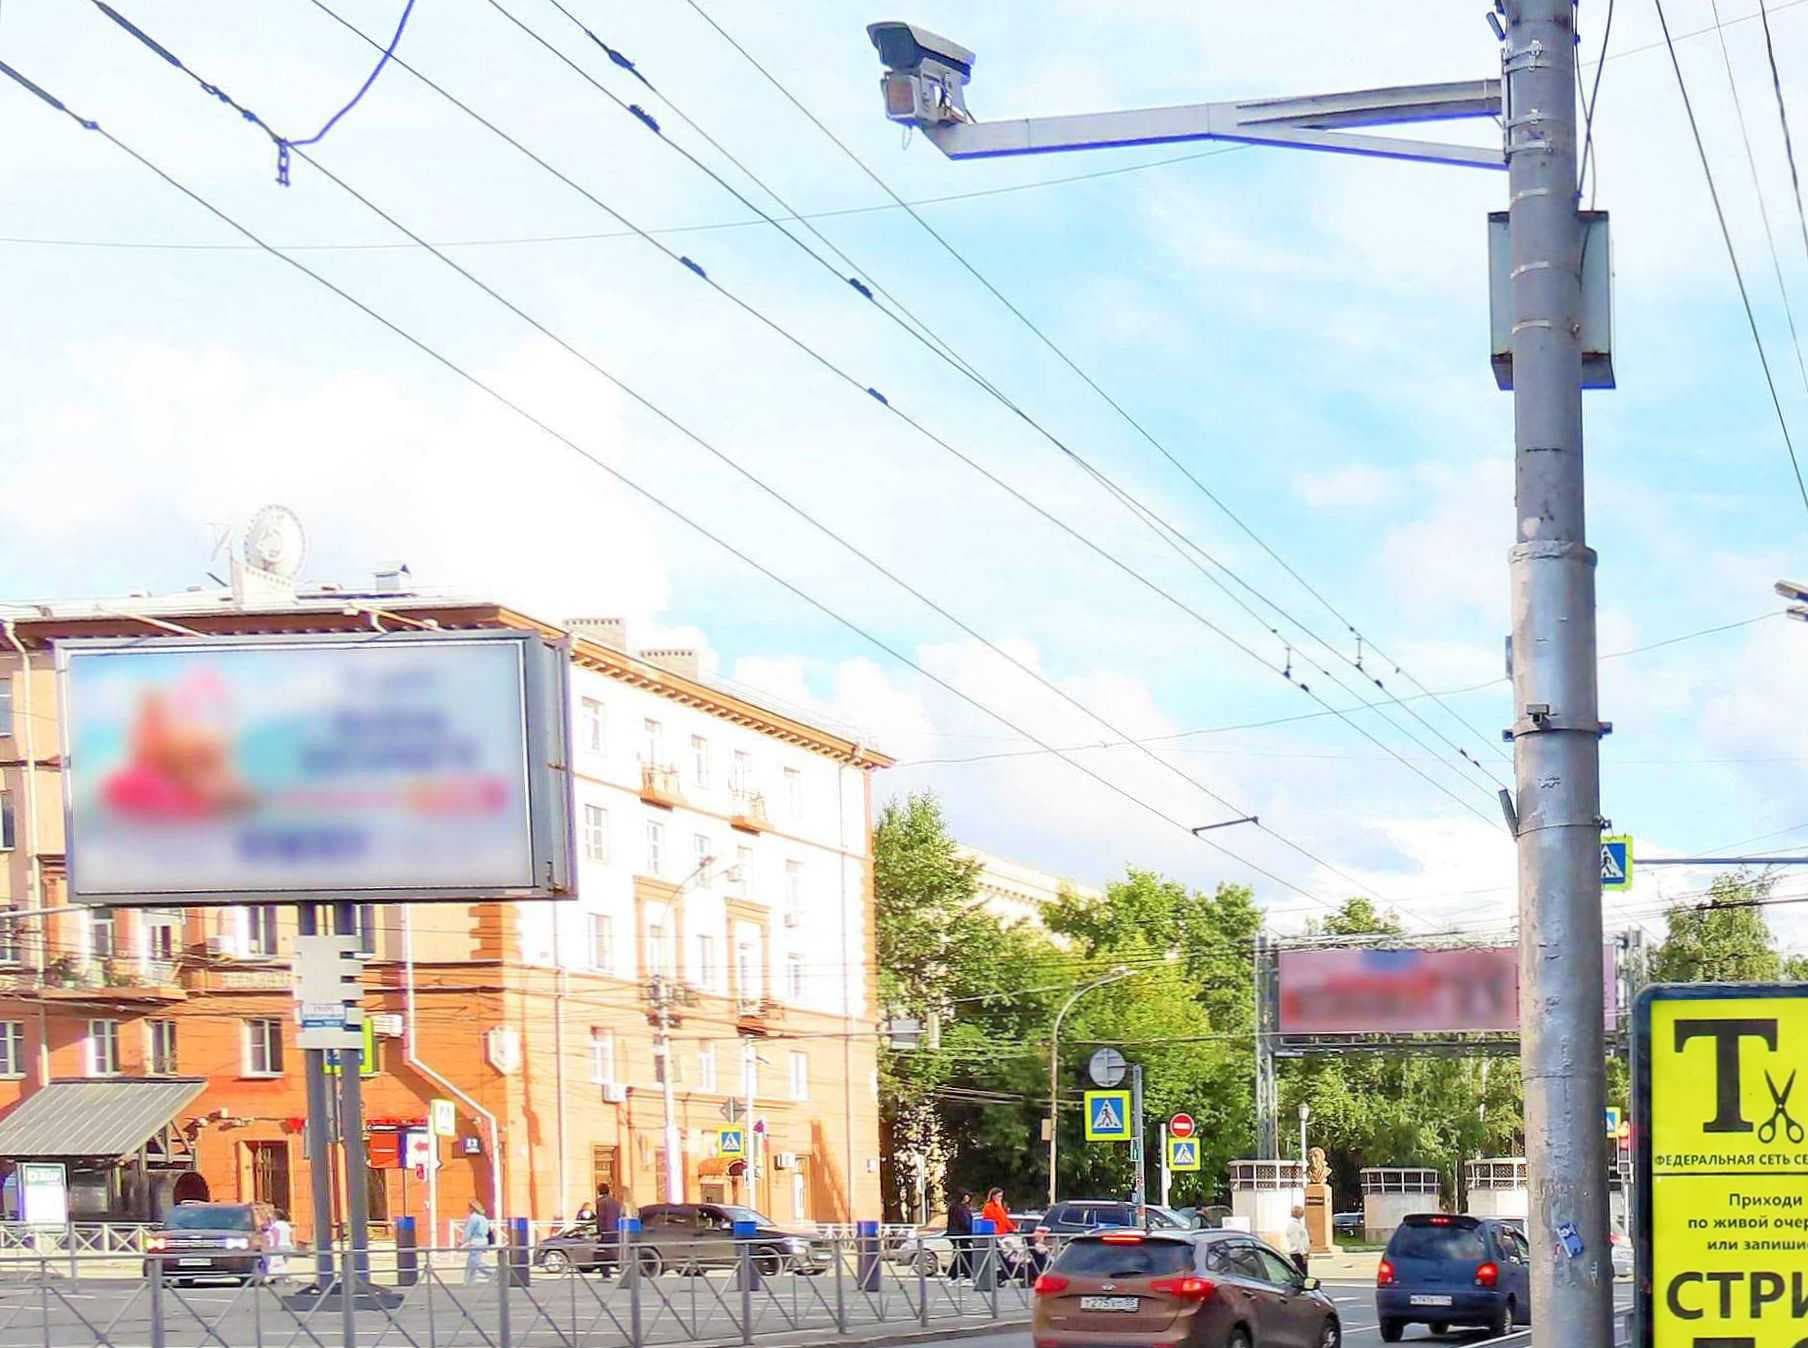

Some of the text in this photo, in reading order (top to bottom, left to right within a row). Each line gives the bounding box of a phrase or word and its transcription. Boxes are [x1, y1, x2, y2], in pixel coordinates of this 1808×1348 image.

[1674, 1019, 1778, 1133] Т
[1655, 1153, 1755, 1166] ФЕДЕРАЛЬНАЯ
[1758, 1153, 1791, 1165] СЕТЬ
[1729, 1193, 1803, 1210] Приходи
[1688, 1219, 1708, 1231] по
[1713, 1215, 1769, 1229] живой
[1707, 1241, 1738, 1251] или
